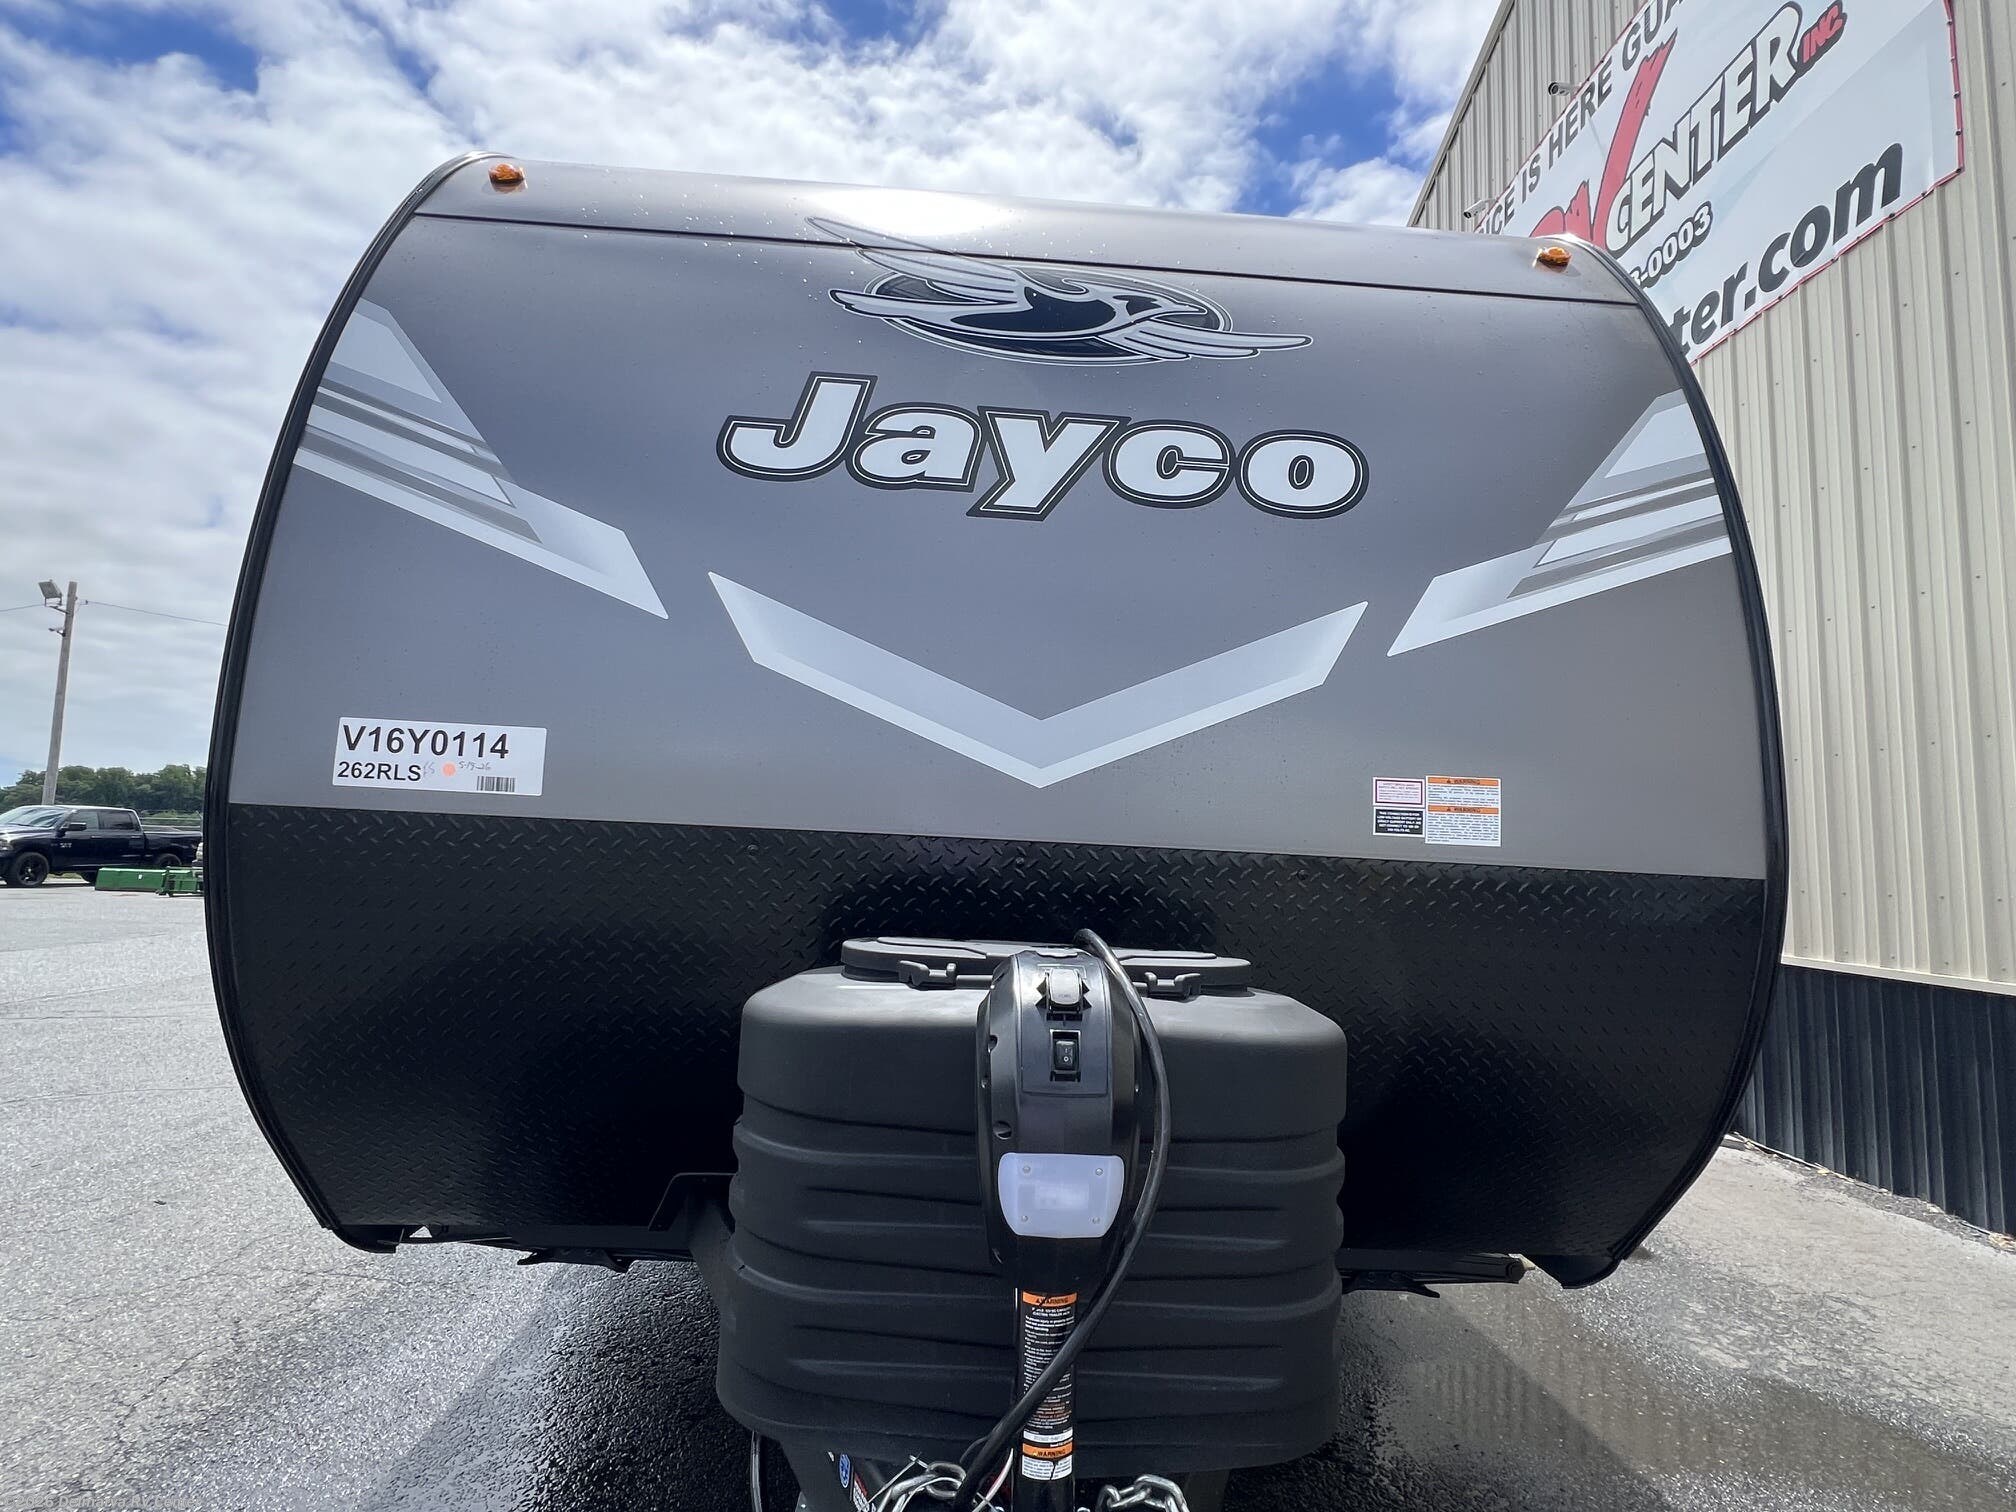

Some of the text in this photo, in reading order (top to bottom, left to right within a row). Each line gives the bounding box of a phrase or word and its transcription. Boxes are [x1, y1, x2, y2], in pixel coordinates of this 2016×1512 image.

[1521, 153, 1541, 205] IS
[1549, 56, 1613, 170] HERE
[1605, 1, 1803, 258] CENTER
[1800, 0, 1847, 76] INC
[716, 371, 1369, 521] Jayco
[337, 761, 421, 782] 262RLS
[343, 725, 509, 759] V16Y0114
[1037, 1448, 1066, 1457] WARNING
